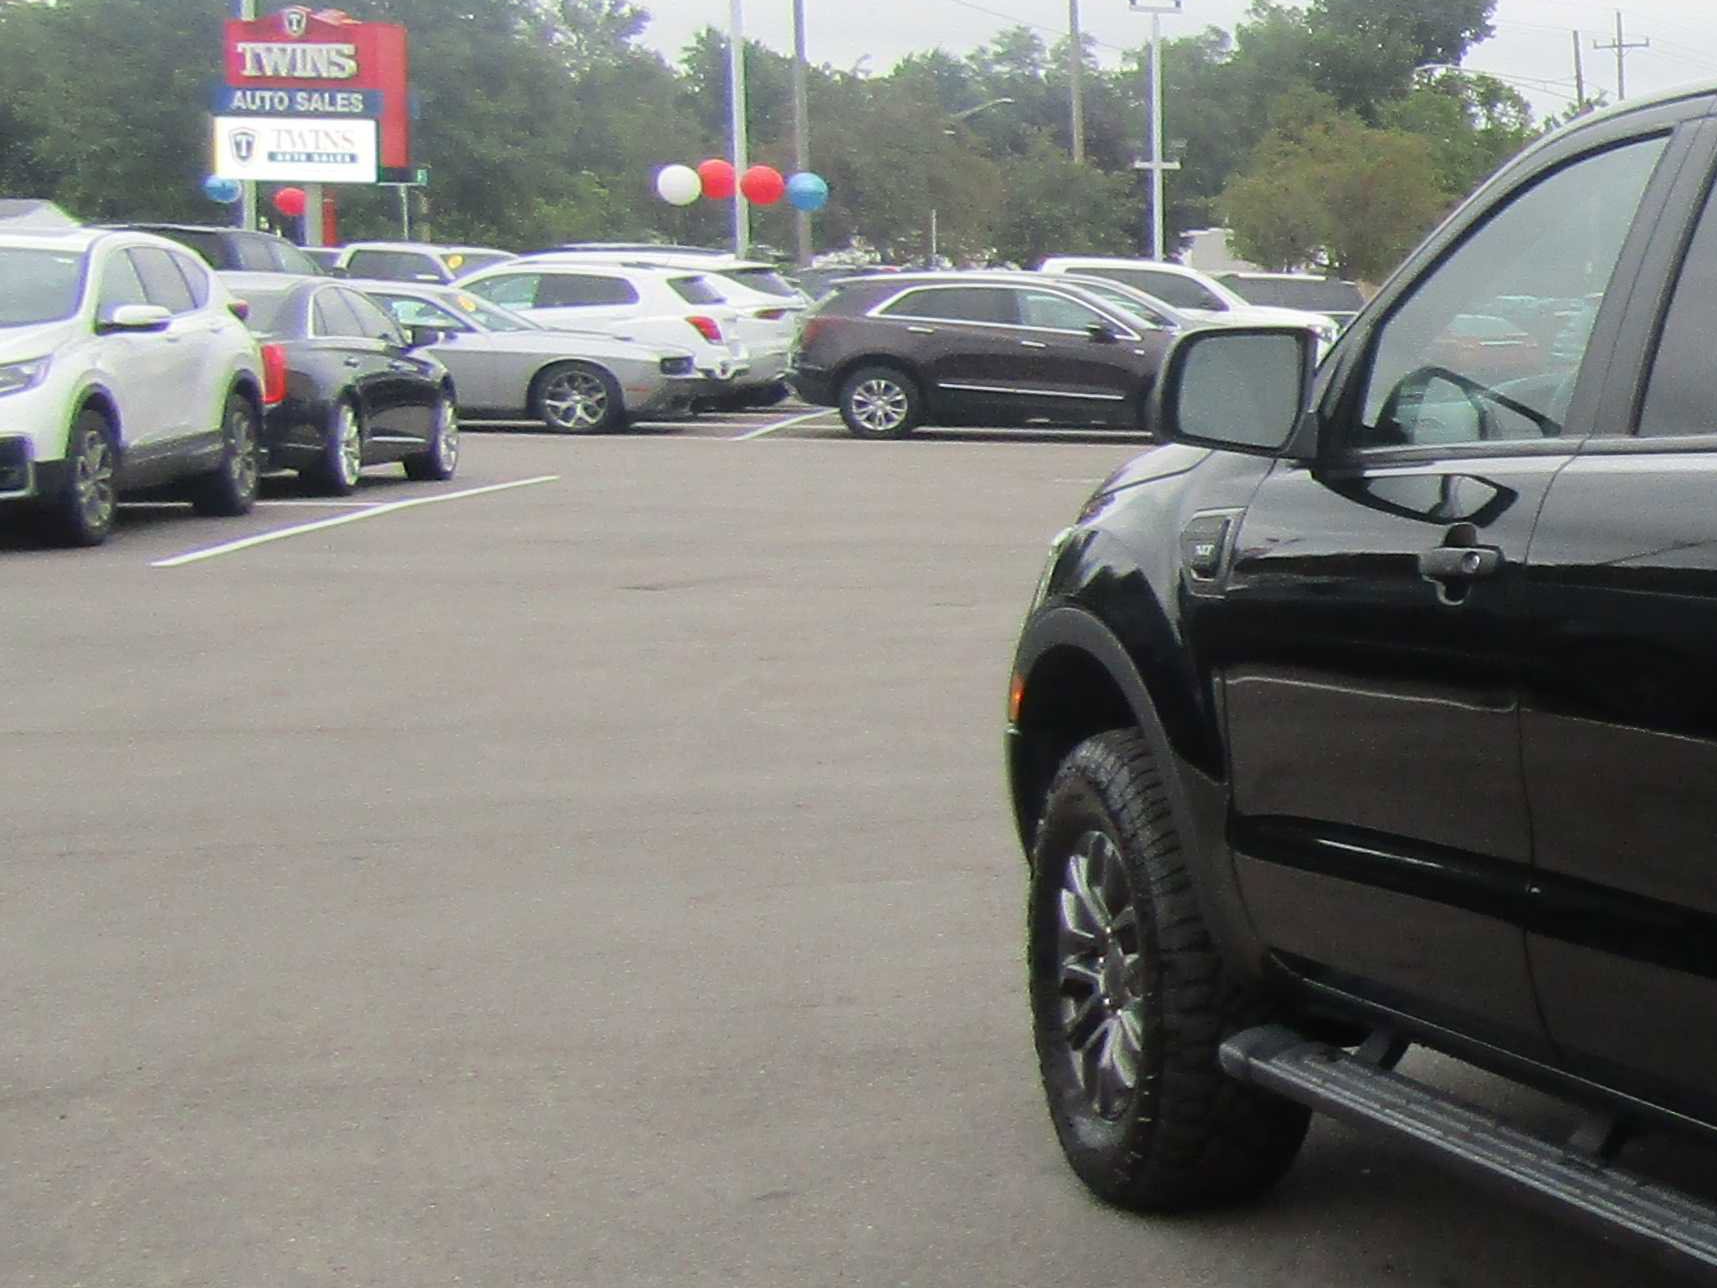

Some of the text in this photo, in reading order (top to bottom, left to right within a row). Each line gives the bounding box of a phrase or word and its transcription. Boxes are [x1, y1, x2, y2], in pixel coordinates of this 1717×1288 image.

[236, 42, 359, 79] TWINS
[231, 90, 363, 112] AUTO SALES
[271, 128, 355, 150] TWINS
